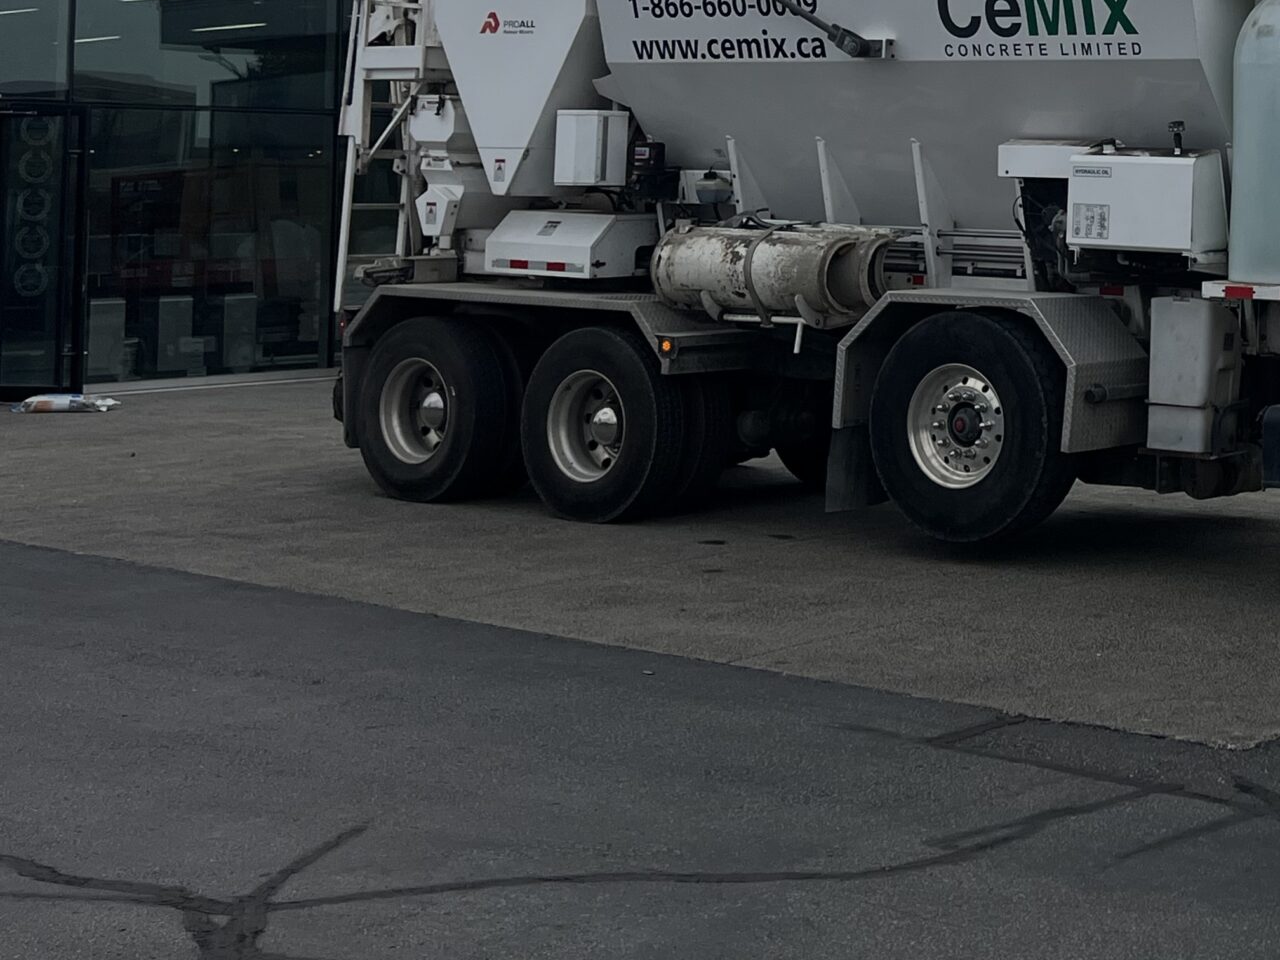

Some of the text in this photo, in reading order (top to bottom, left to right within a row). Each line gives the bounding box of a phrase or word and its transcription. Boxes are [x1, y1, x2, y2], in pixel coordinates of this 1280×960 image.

[503, 20, 536, 28] PROALL
[632, 29, 827, 60] www.cemix.ca
[944, 42, 1142, 57] CONCRETE LIMITED
